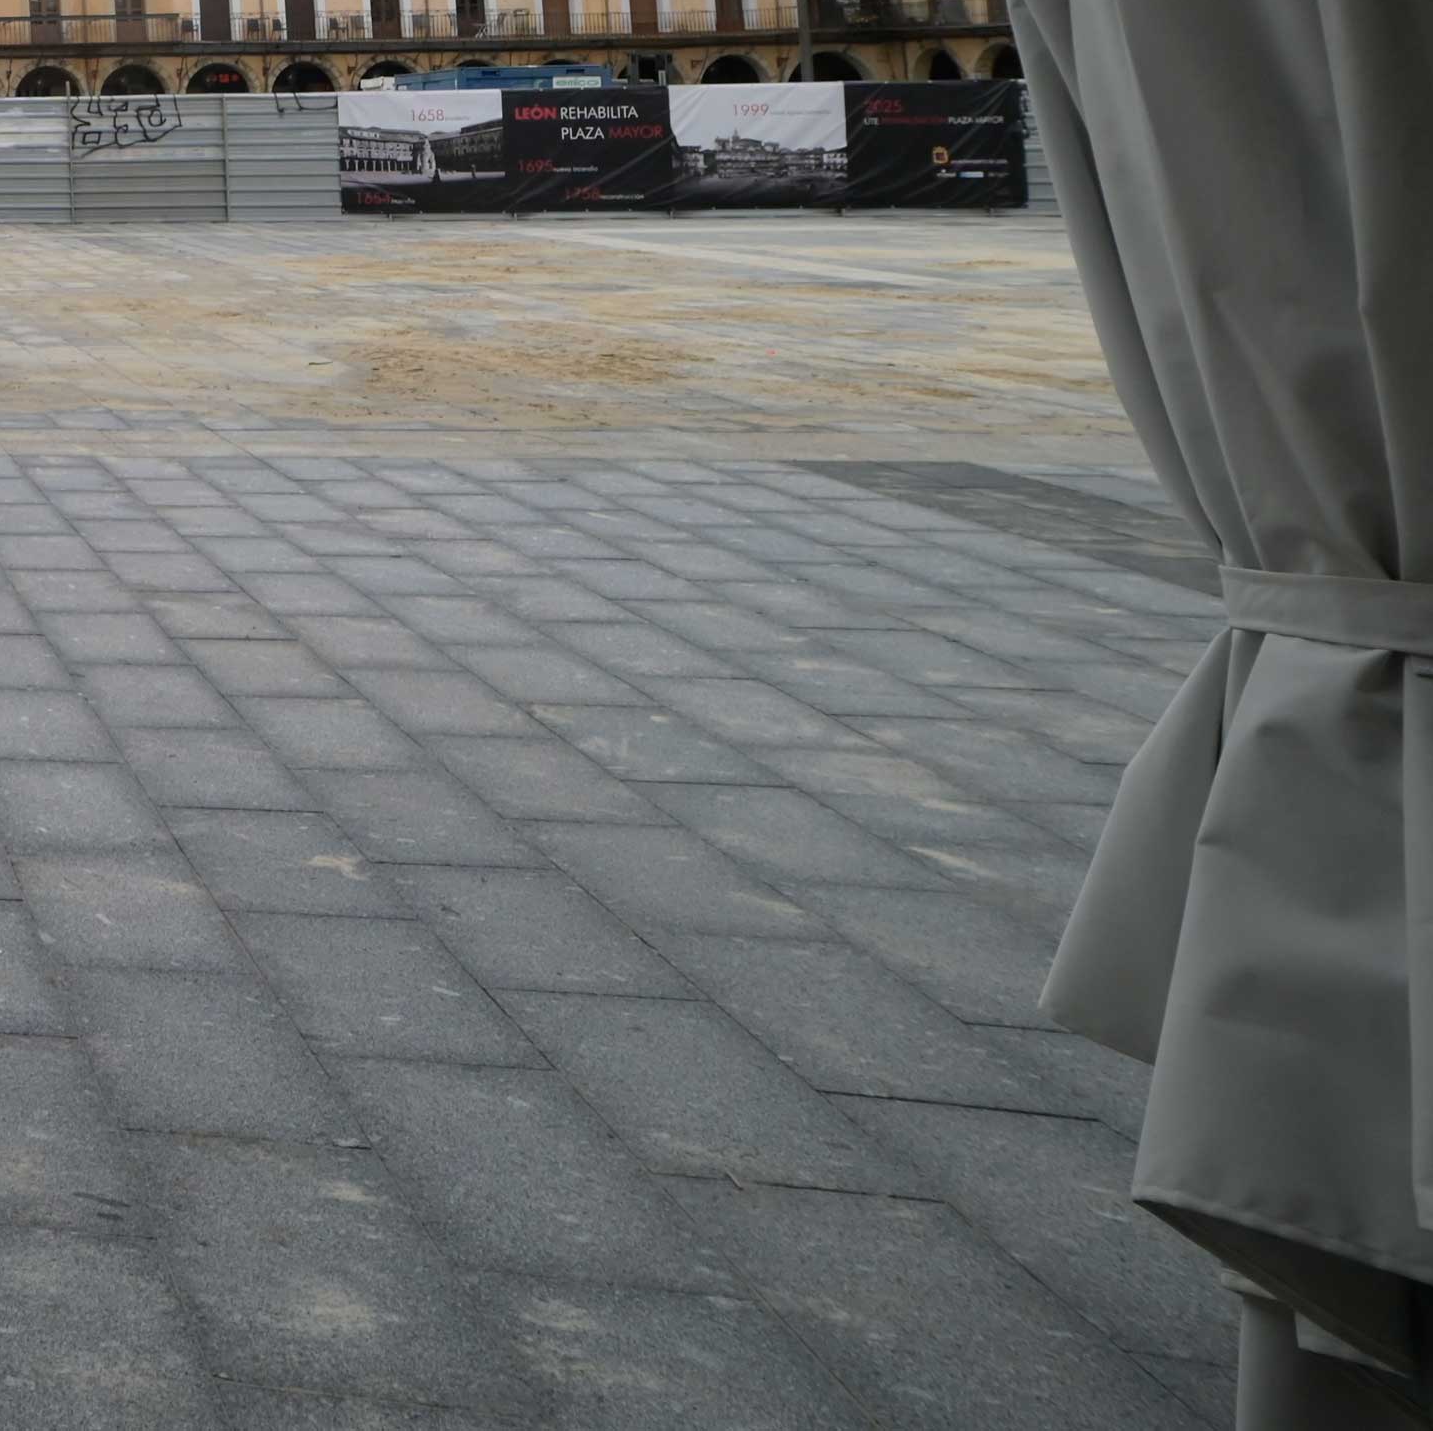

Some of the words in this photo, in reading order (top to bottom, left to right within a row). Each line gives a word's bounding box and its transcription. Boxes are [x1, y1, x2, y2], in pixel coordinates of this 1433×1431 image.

[411, 109, 444, 121] 1658
[514, 105, 557, 120] LEÓN
[560, 106, 639, 120] REHABILITA
[733, 105, 769, 116] 1999
[948, 116, 972, 124] PLAZA
[561, 127, 605, 140] PLAZA
[608, 125, 664, 138] MAYOR
